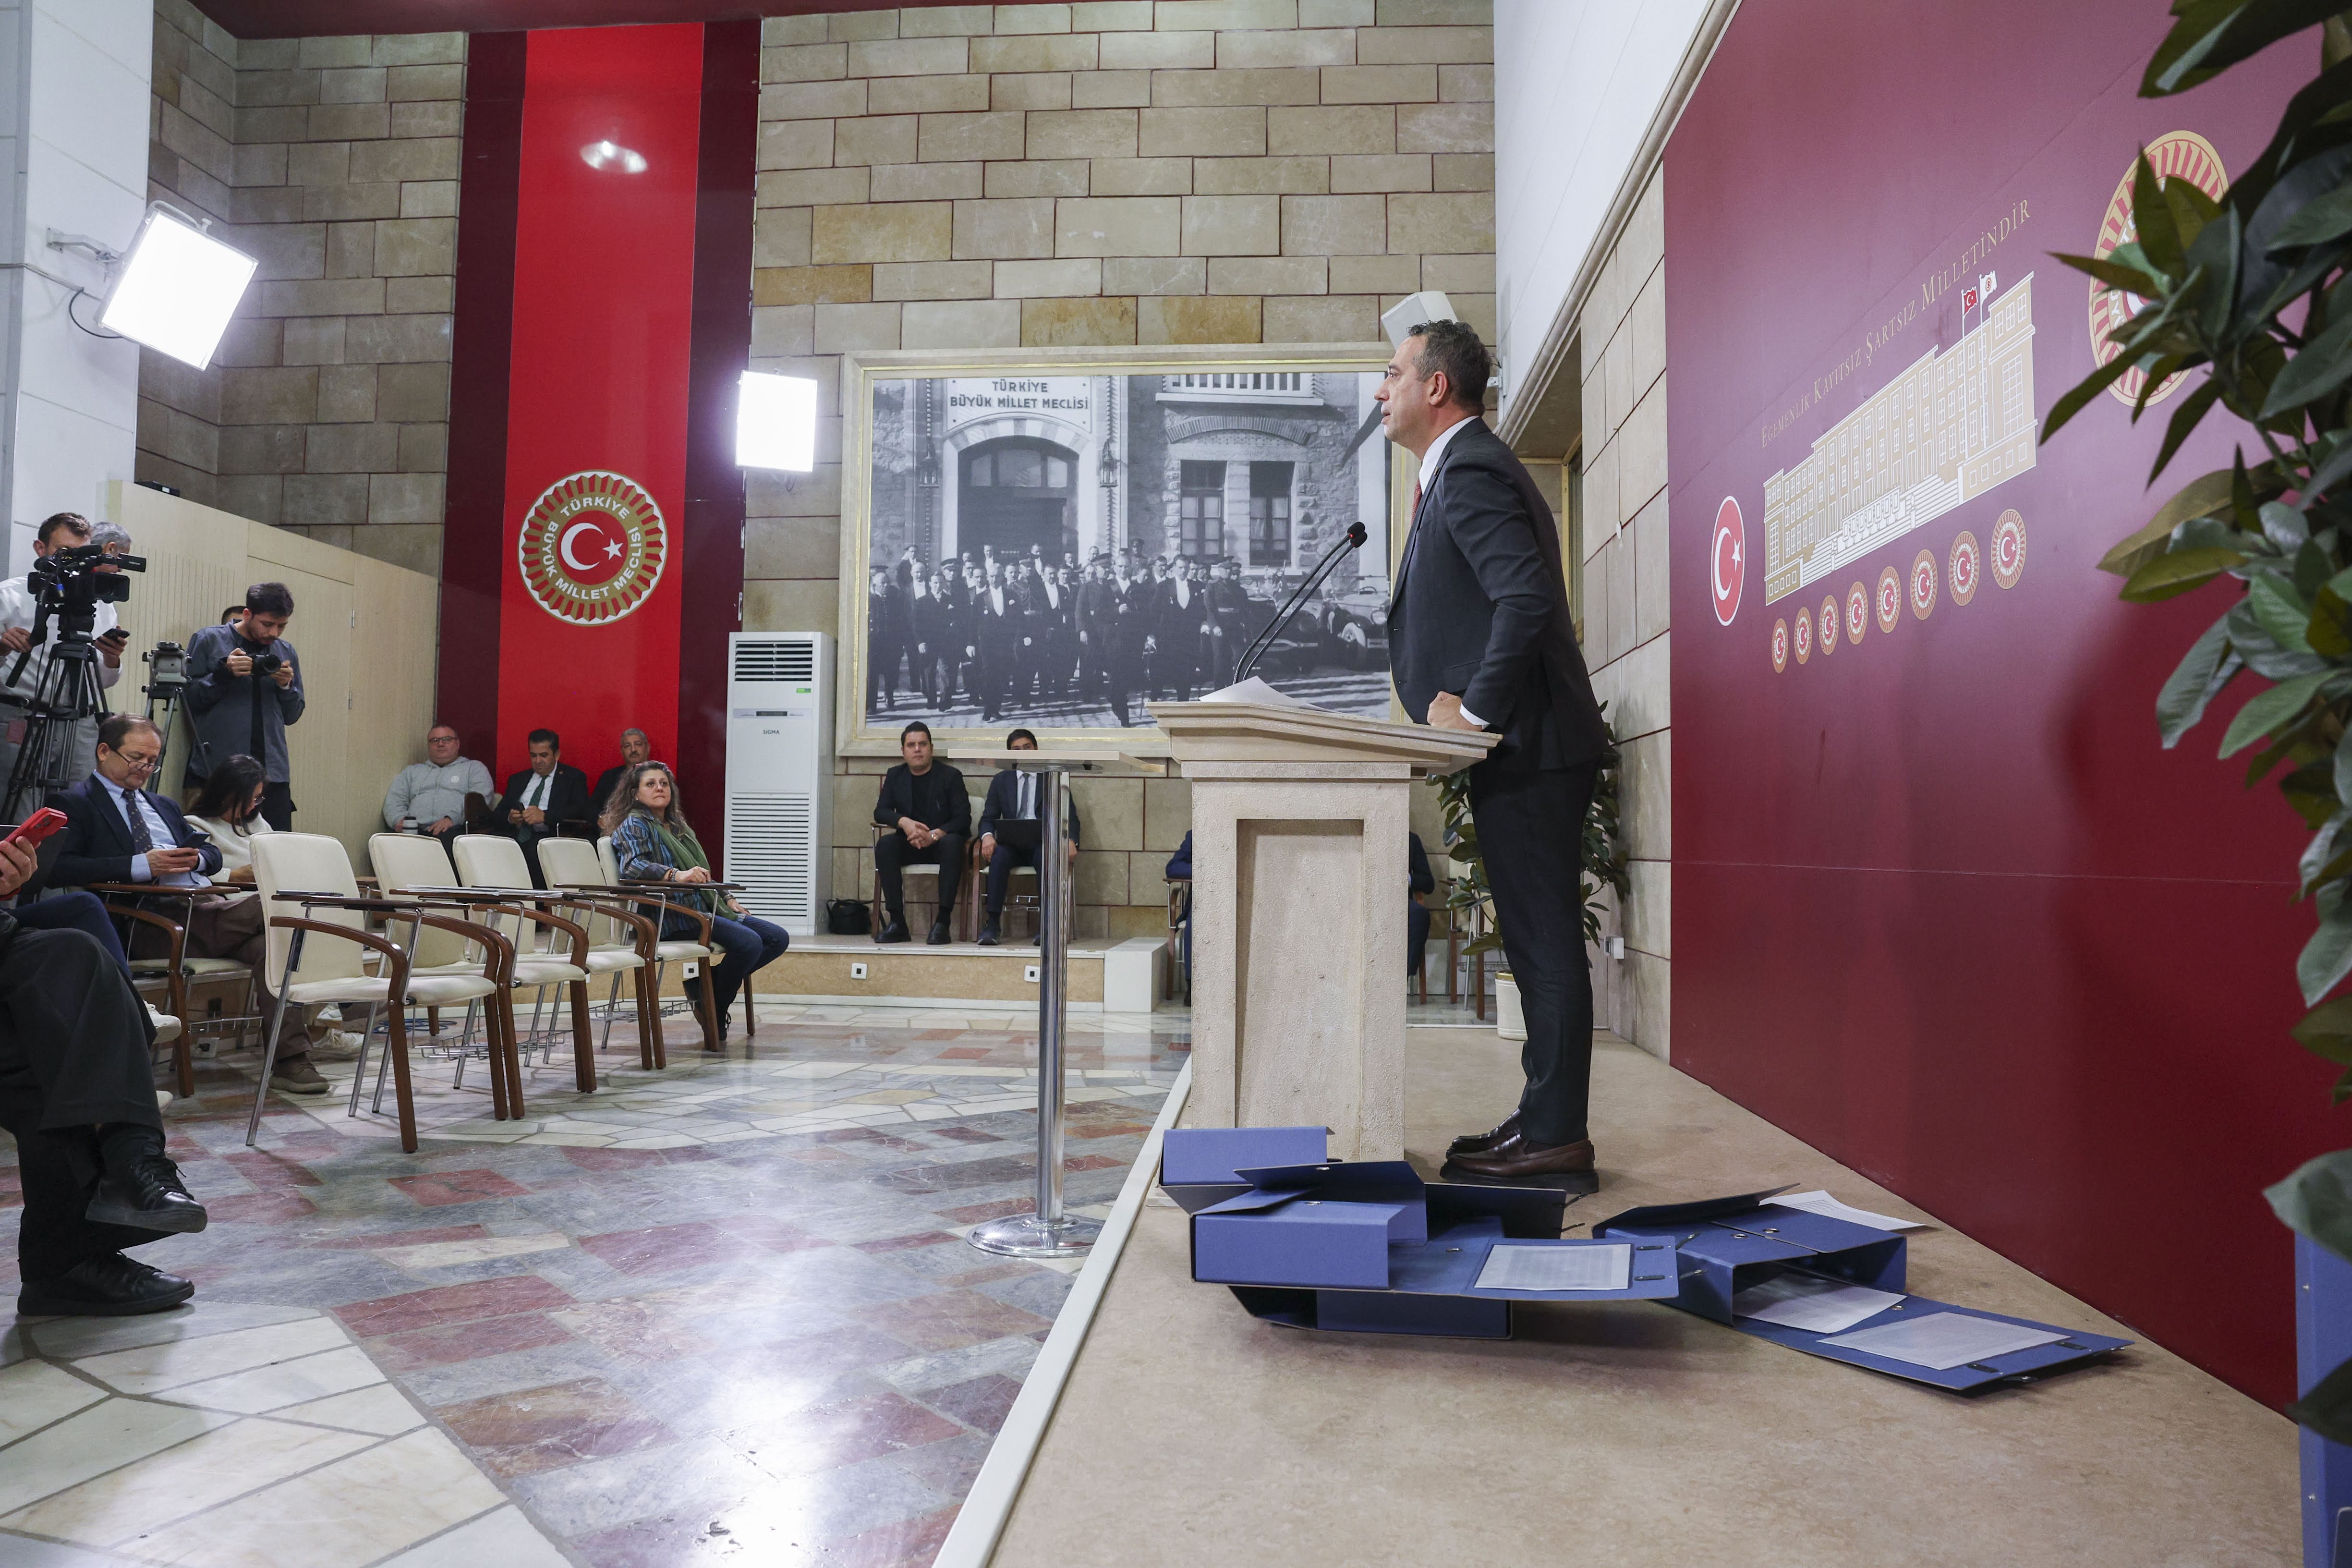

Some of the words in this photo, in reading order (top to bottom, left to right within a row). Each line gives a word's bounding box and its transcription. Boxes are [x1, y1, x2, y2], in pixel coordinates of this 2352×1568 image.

[992, 378, 1048, 393] TÜRKİYE
[950, 394, 992, 407] BÜYÜK
[997, 395, 1038, 408] MİLLET
[1042, 396, 1088, 409] MECLİSİ
[560, 496, 630, 520] TÜRKİYE
[542, 521, 559, 578] BÜYÜK
[613, 526, 642, 591] MECLİSİ
[555, 577, 609, 600] MİLLET
